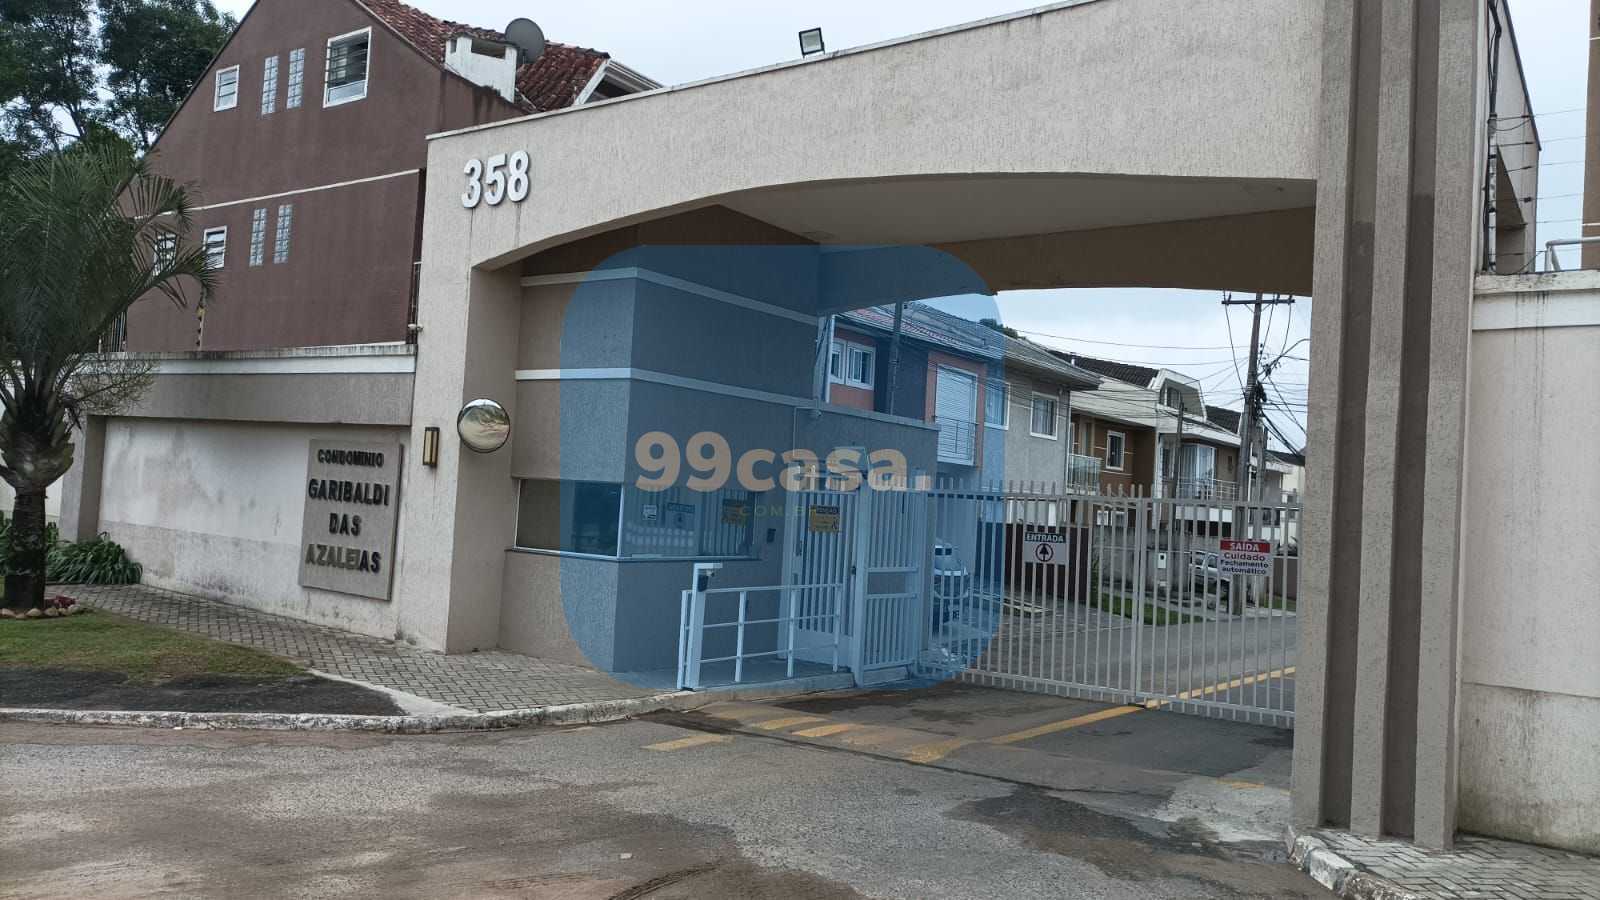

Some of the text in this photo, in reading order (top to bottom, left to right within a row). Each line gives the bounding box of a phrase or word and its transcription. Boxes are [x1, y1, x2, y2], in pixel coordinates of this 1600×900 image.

[461, 150, 529, 208] 358
[308, 479, 390, 506] GARIBALDI
[329, 513, 362, 536] DAS
[1026, 533, 1064, 542] ENTRADA
[305, 544, 382, 573] AZALEIAS
[1220, 559, 1269, 569] Fechamento
[1223, 552, 1266, 562] Cuidado
[1222, 566, 1266, 575] automático
